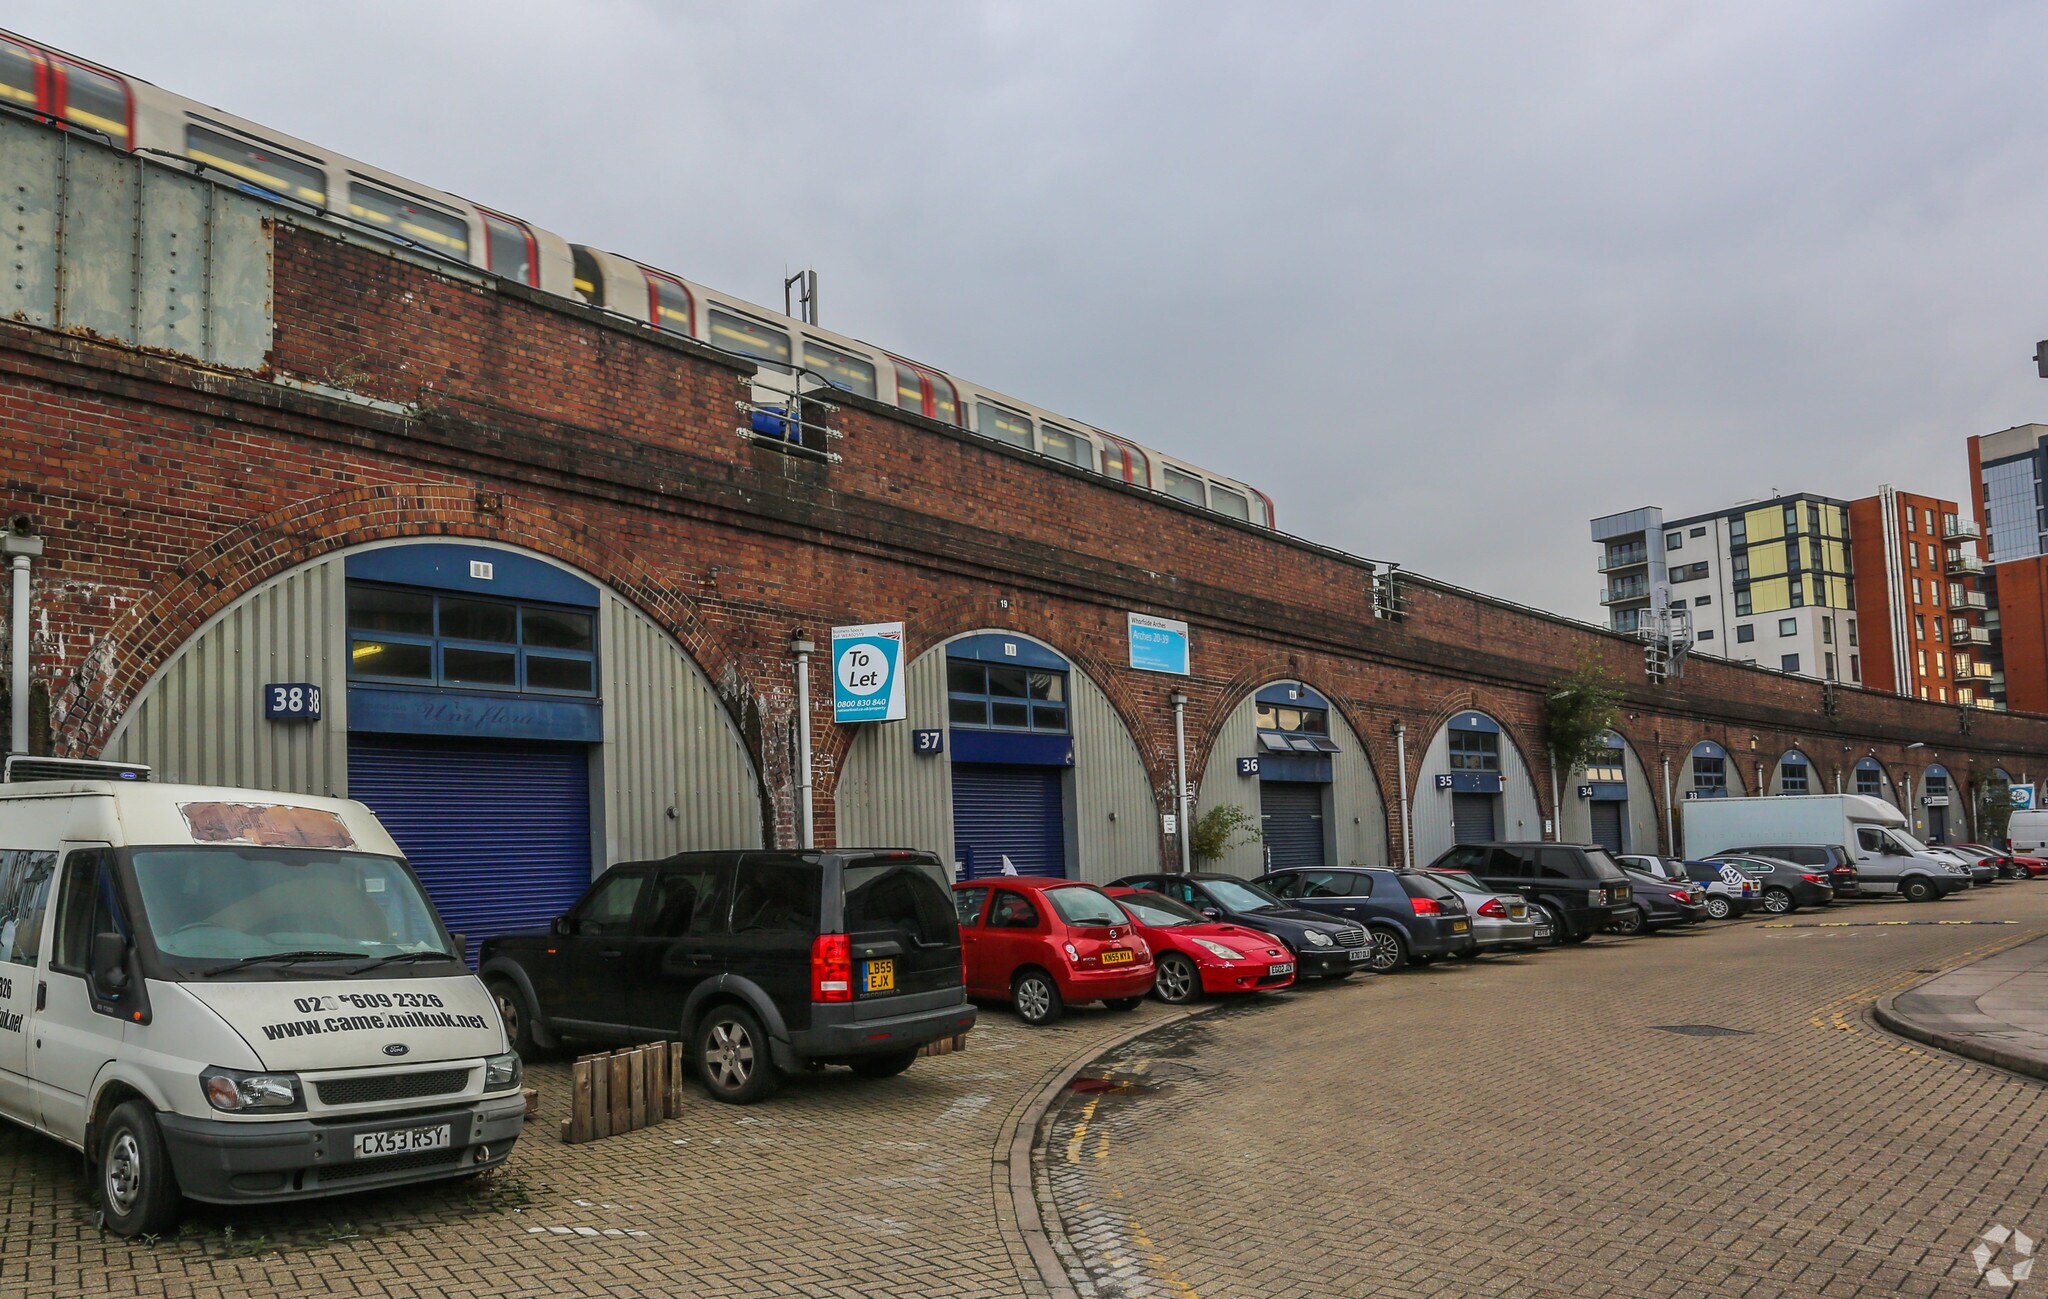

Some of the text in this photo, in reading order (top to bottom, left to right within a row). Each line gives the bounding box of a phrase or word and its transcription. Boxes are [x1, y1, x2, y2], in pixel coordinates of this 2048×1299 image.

[1000, 600, 1008, 608] 19
[1153, 621, 1166, 629] Arches
[1133, 630, 1169, 644] Arches 20-39
[849, 651, 869, 667] To
[849, 671, 877, 687] Let
[273, 687, 303, 712] 38
[308, 688, 320, 713] 38
[837, 698, 886, 708] 0800 830 840
[920, 732, 940, 749] 37
[1242, 759, 1258, 772] 36
[1439, 776, 1452, 787] 35
[1581, 787, 1593, 796] 34
[868, 961, 892, 975] LB55
[871, 975, 889, 988] EJX
[393, 993, 444, 1008] 2326
[362, 1127, 443, 1155] CX53 RSY
